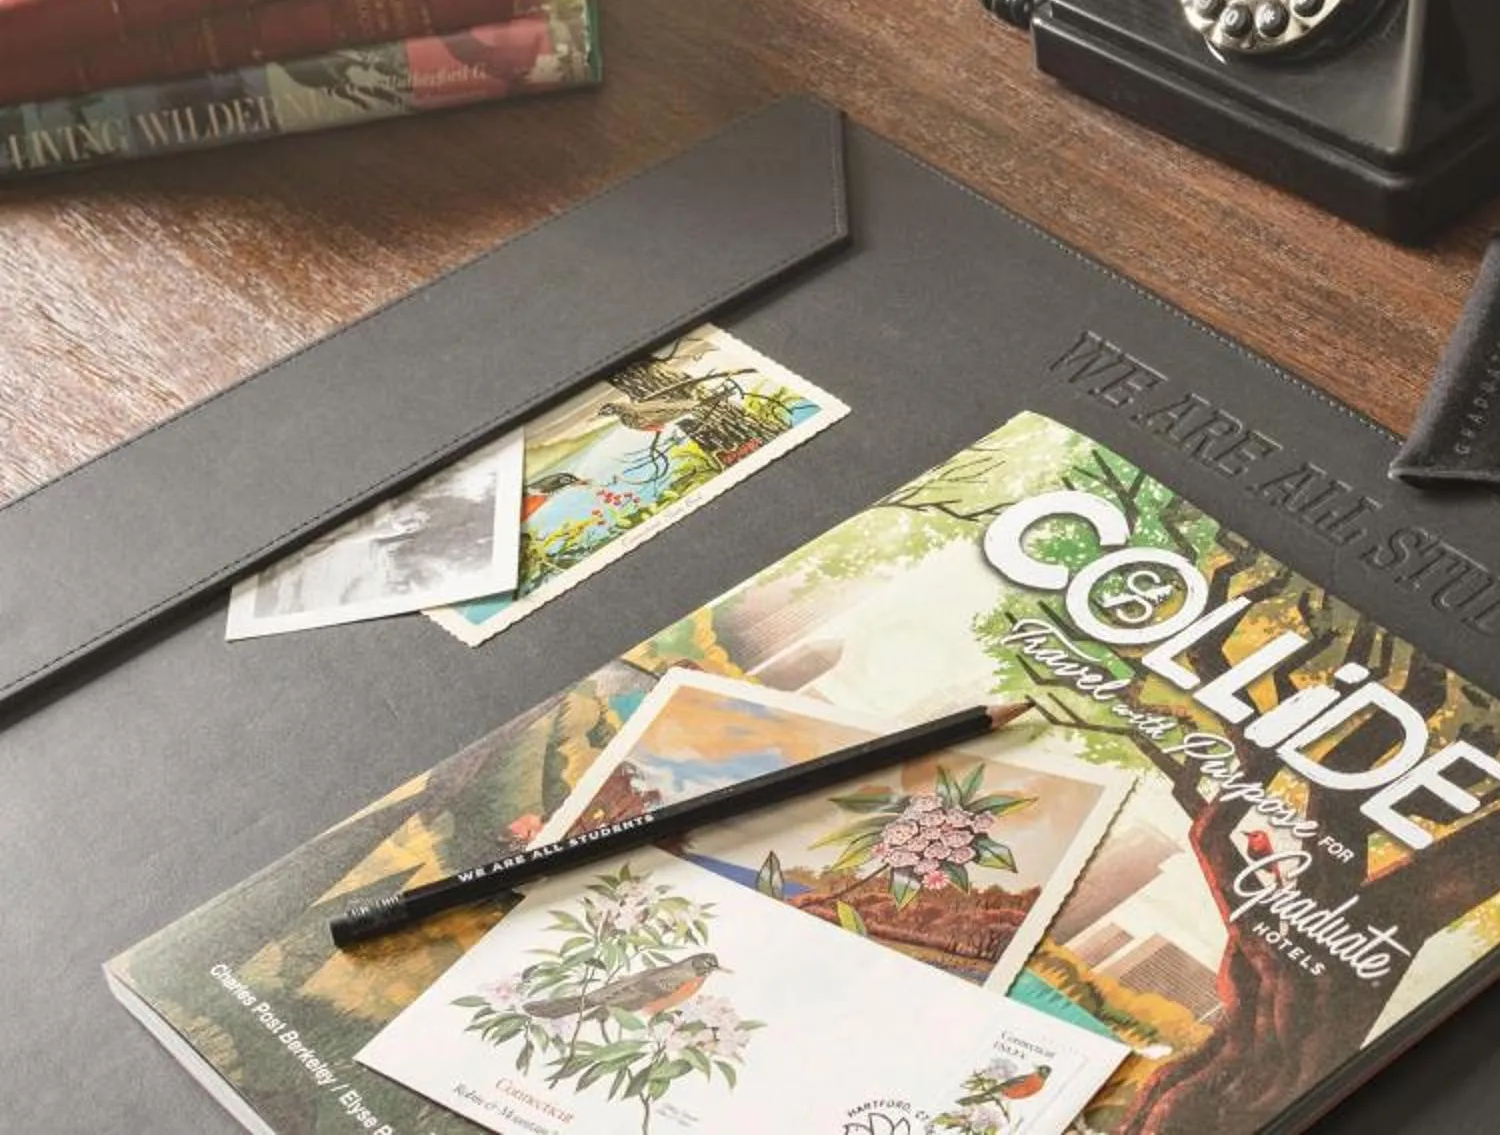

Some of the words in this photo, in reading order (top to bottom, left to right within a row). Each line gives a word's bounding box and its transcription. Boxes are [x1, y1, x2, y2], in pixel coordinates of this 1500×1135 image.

[1050, 330, 1169, 409] WE
[1130, 392, 1284, 479] ARE
[1245, 462, 1383, 545] ALL
[1001, 618, 1133, 702] Travel
[1111, 703, 1178, 740] with
[1161, 731, 1320, 838] Purpose
[1317, 835, 1355, 863] FOR
[458, 867, 486, 883] WE
[492, 853, 527, 873] ARE
[532, 843, 564, 859] ALL
[568, 814, 655, 848] STUDENTS
[1229, 850, 1412, 979] Graduate
[1252, 921, 1328, 977] HOTELS
[210, 964, 257, 1006] Charles
[251, 1002, 288, 1034] Post
[278, 1029, 338, 1085] Berkeley
[339, 1090, 378, 1129] Elyse
